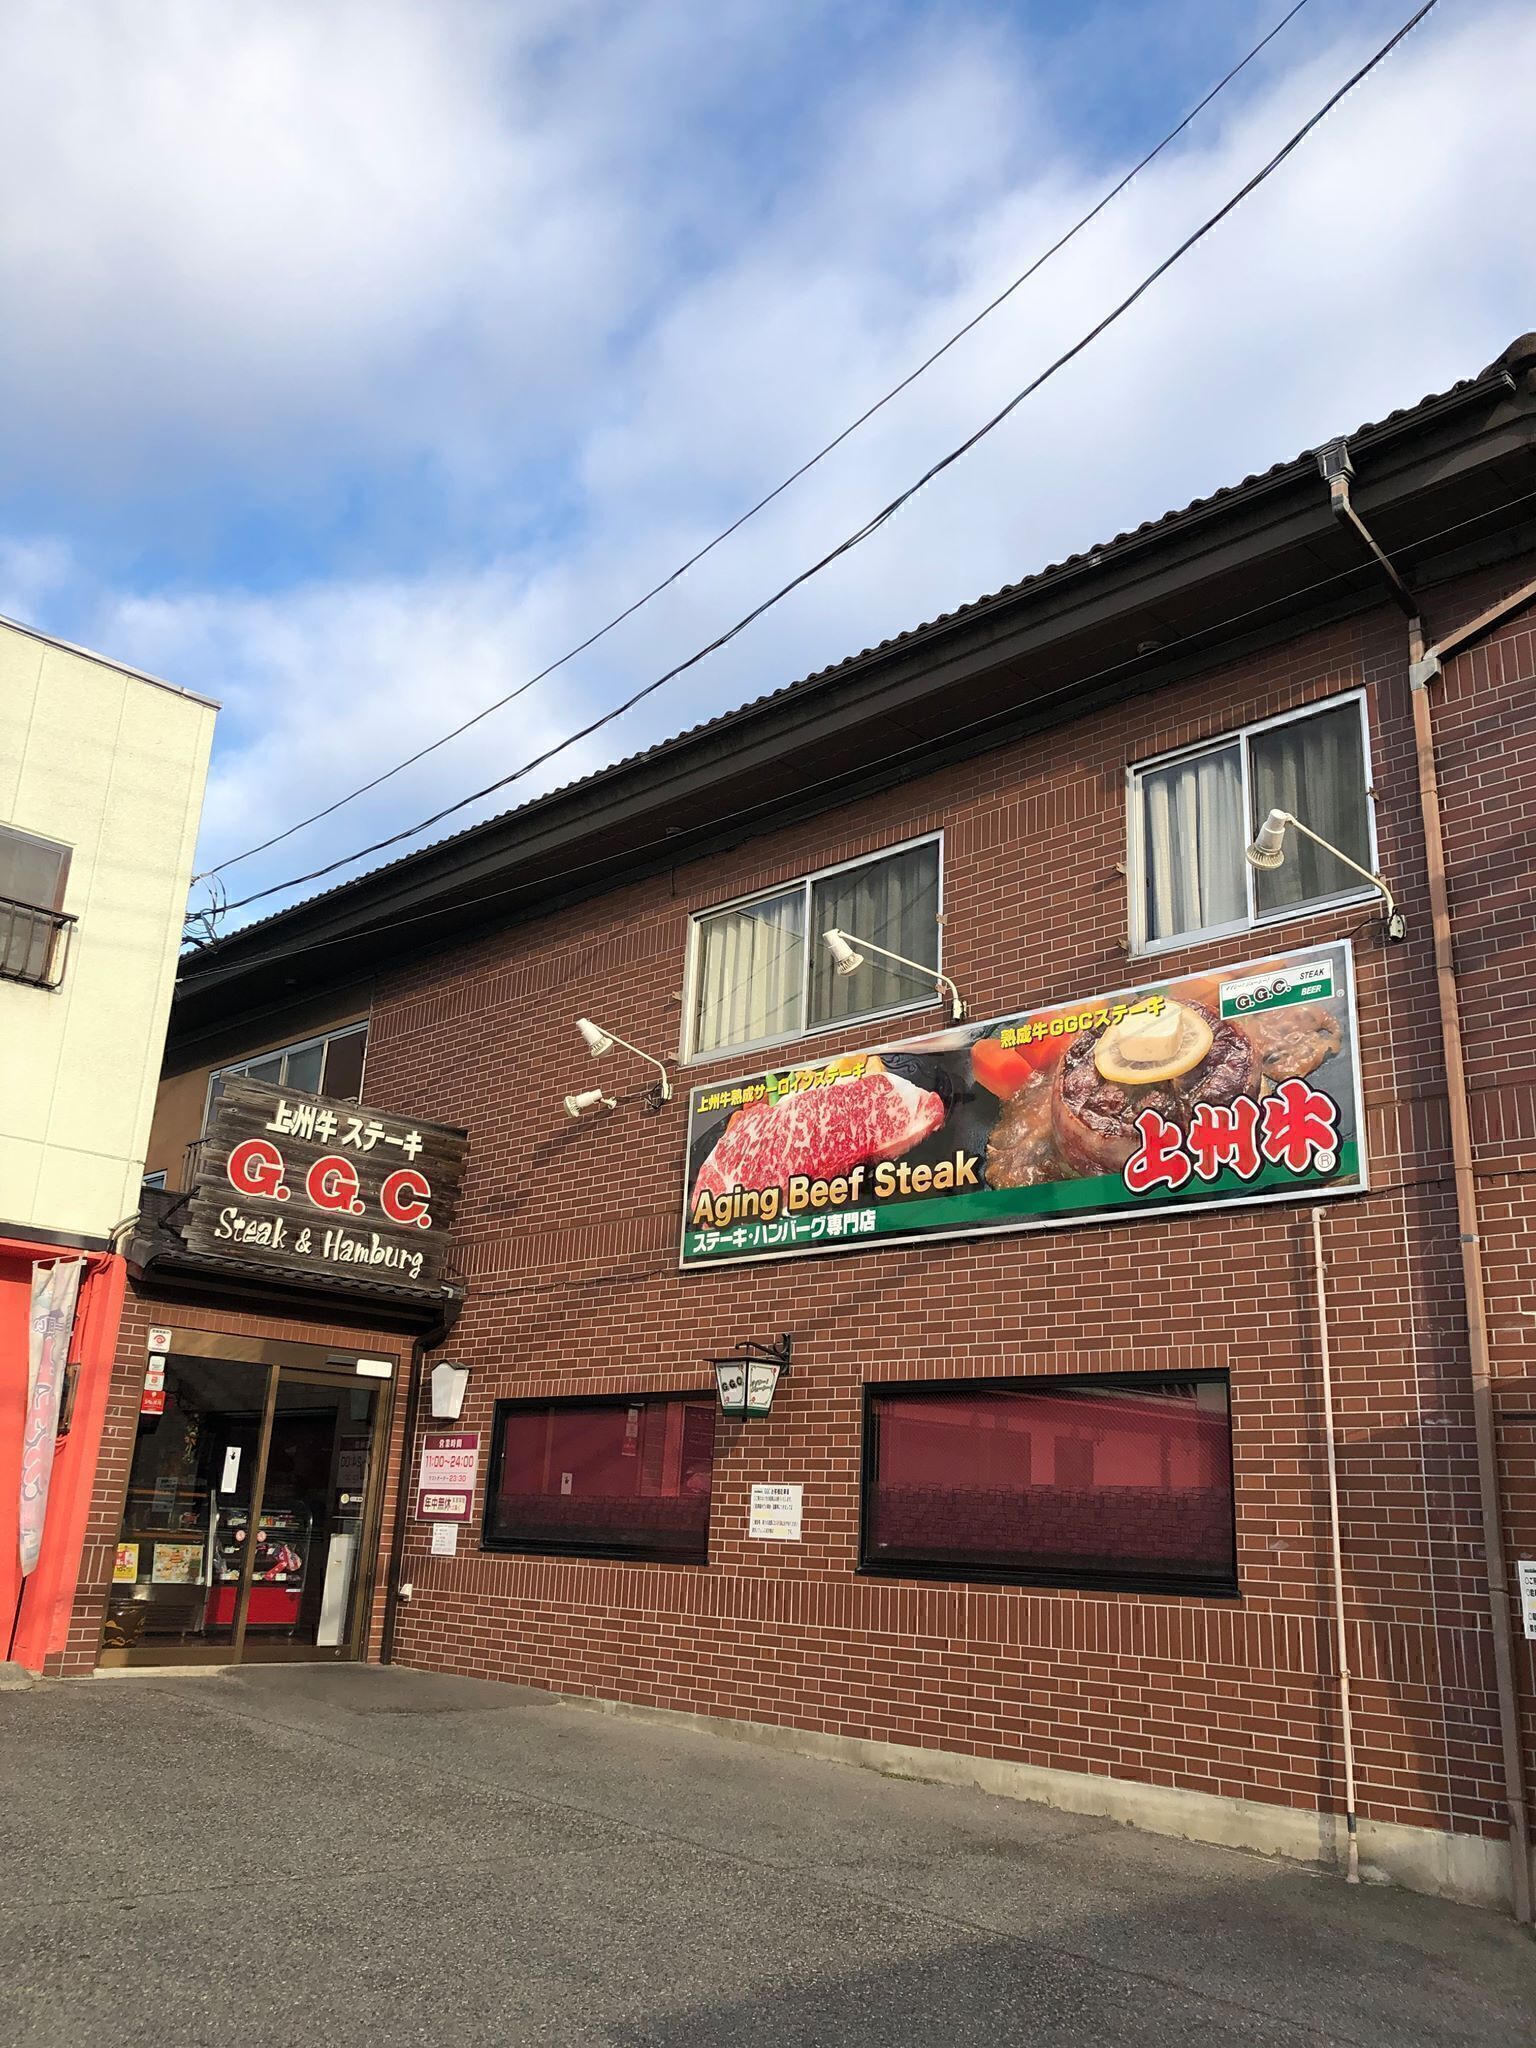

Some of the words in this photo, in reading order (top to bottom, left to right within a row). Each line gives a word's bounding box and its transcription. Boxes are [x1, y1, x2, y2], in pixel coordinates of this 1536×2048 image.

[1299, 968, 1325, 980] STEAK
[1301, 984, 1322, 996] BEER
[1000, 994, 1166, 1049] 熟成牛GGCステーキ
[697, 1063, 867, 1113] 上州牛熟成サーロインステーキ
[1124, 1078, 1338, 1192] 上州牛
[692, 1185, 780, 1227] Aging
[788, 1166, 866, 1210] Beef
[874, 1150, 979, 1197] Steak
[215, 1208, 288, 1249] Steak
[295, 1228, 312, 1254] &
[323, 1230, 424, 1279] Hamburg
[692, 1210, 877, 1253] ステーキ・ハンバーグ専門店
